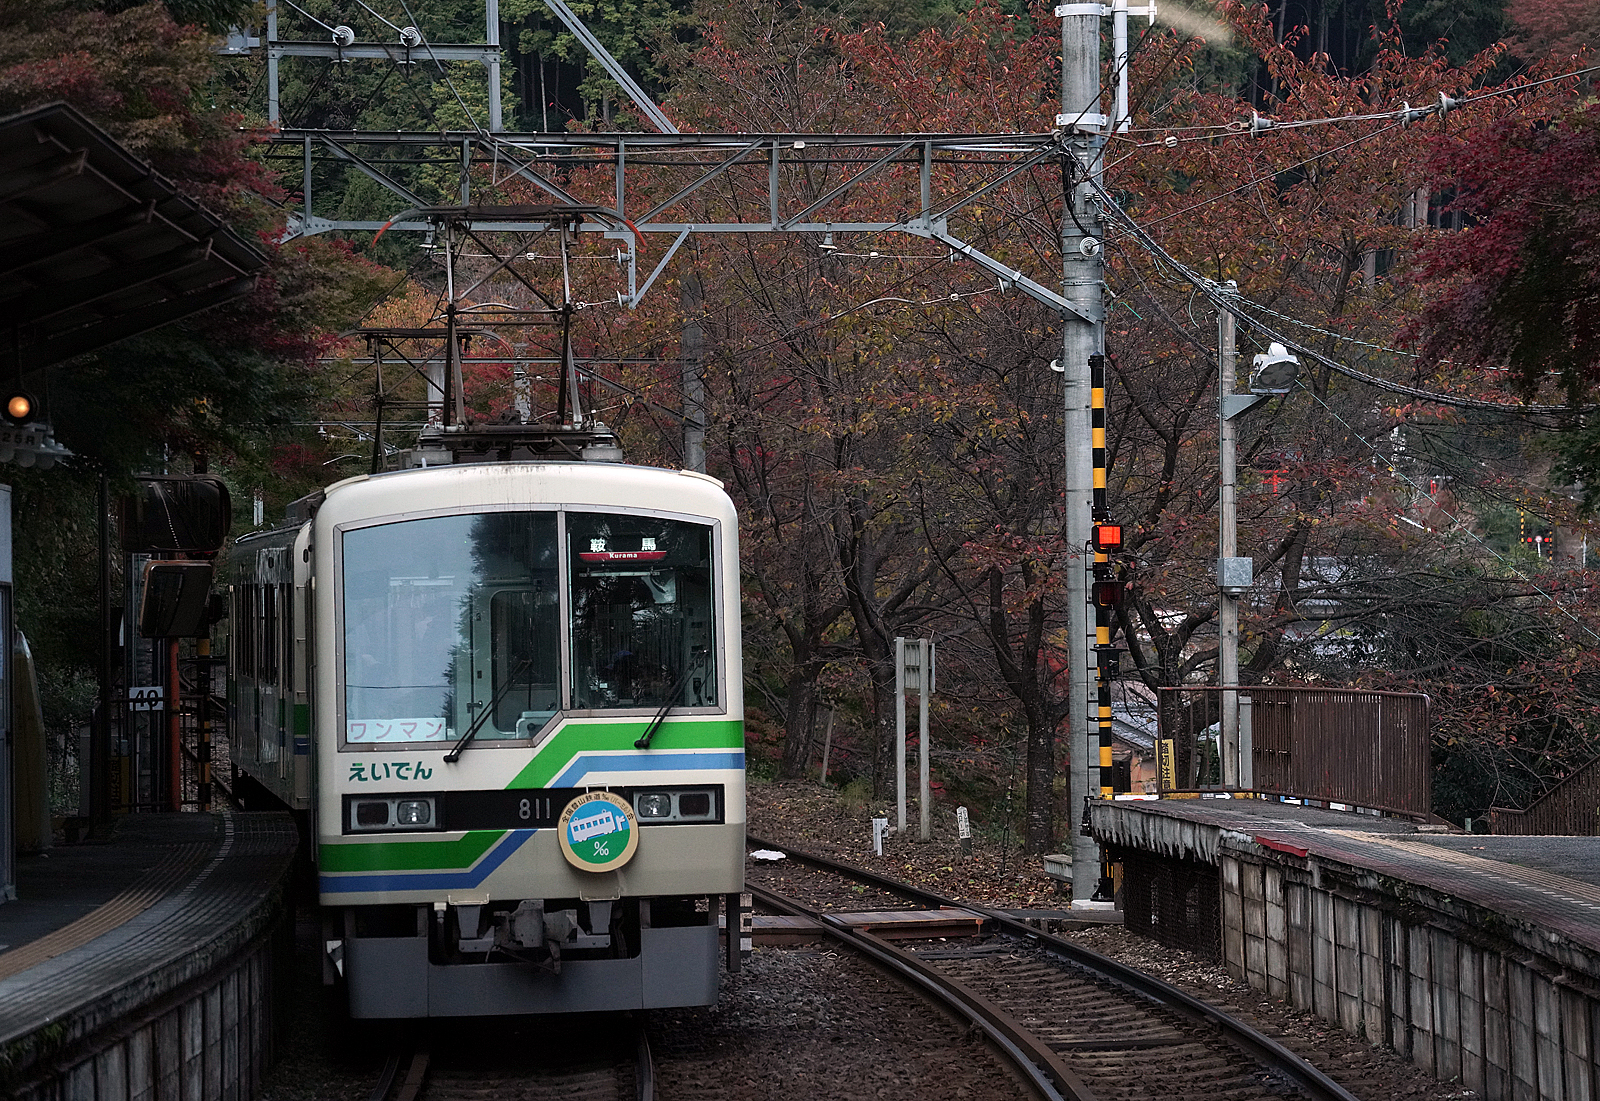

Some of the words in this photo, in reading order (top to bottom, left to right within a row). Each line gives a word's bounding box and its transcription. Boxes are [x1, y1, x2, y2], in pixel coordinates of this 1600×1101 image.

[609, 552, 638, 560] Kurama
[135, 689, 159, 708] 40
[350, 722, 442, 740] ワンマン
[348, 761, 433, 782] えいでん
[518, 798, 551, 819] 811
